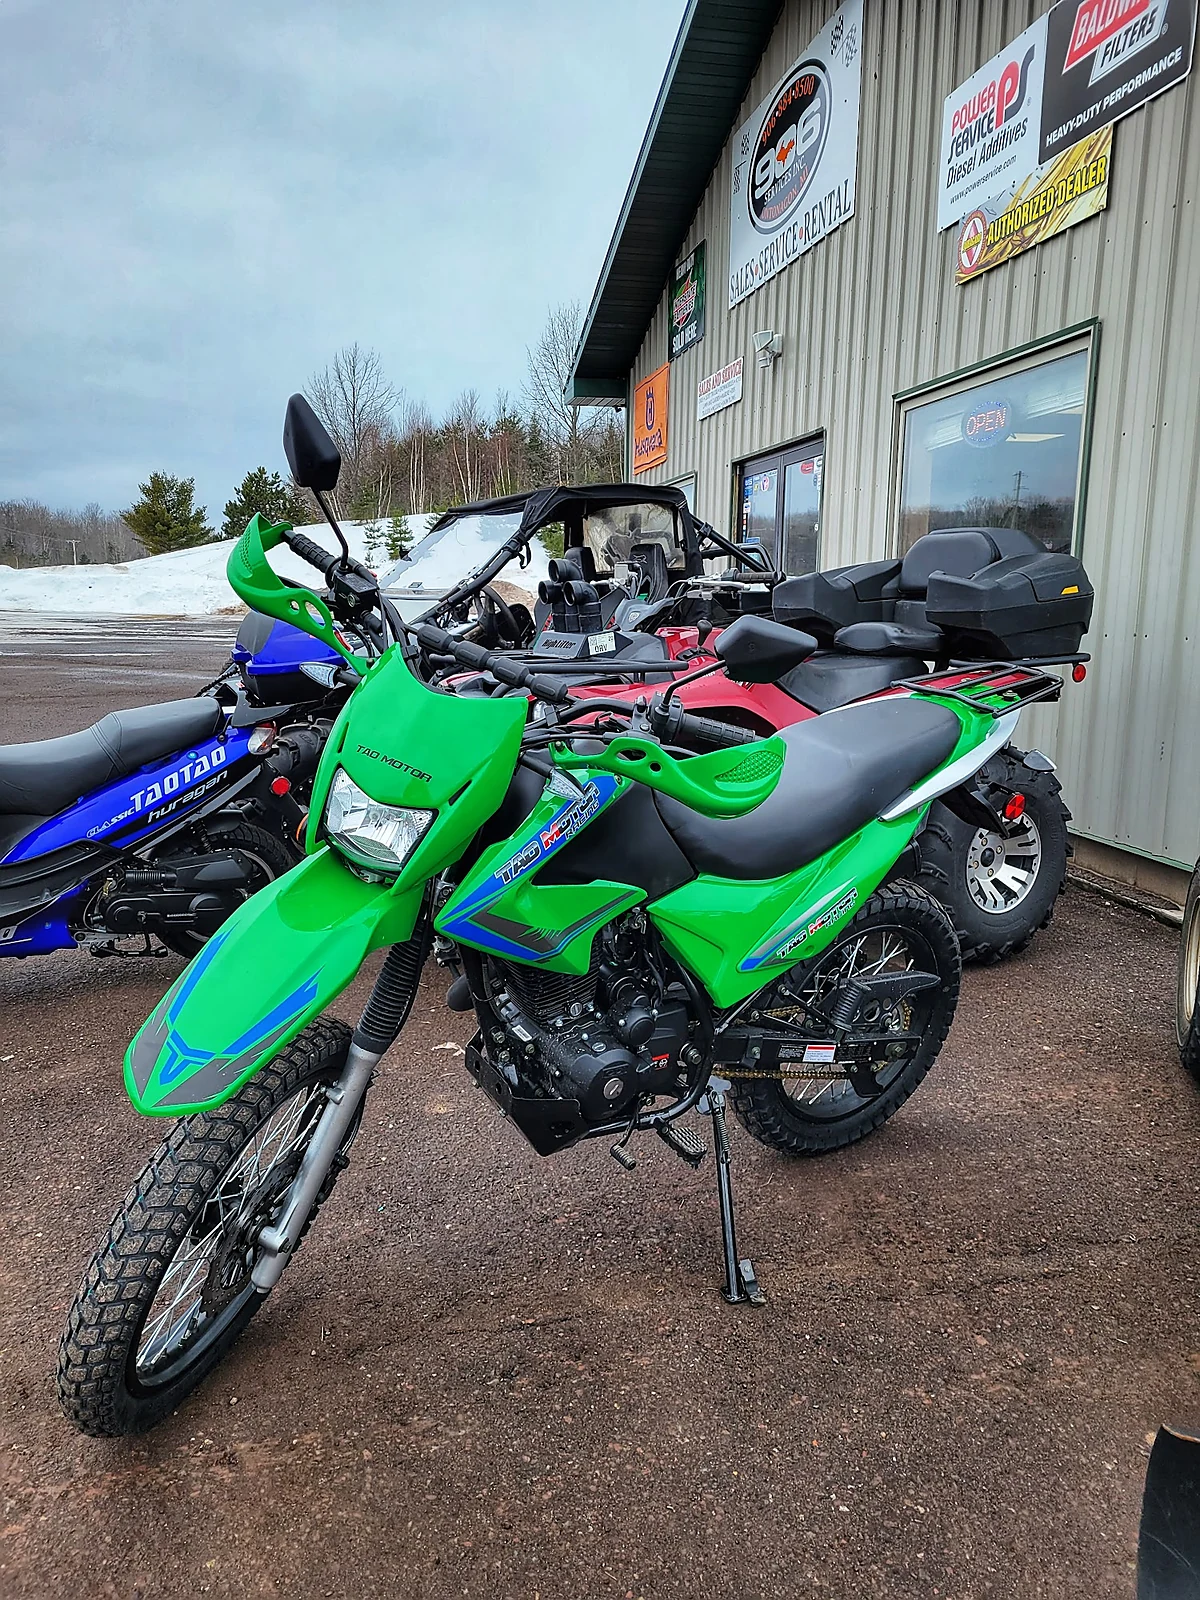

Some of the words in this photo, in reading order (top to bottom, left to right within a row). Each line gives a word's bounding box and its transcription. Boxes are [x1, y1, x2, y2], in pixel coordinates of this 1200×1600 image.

[1074, 0, 1142, 52] BALD
[1101, 6, 1158, 68] FILTERS
[951, 80, 997, 136] POWER
[1045, 99, 1103, 148] HEAVY-DUTY
[1102, 46, 1183, 112] PERFORMANCE
[755, 97, 821, 199] 906
[946, 149, 977, 189] Diesel
[978, 117, 1028, 168] Additives
[947, 106, 996, 165] SERVICE
[764, 169, 792, 205] SERVICES
[950, 154, 1018, 205] www.powerservice.com
[986, 186, 1055, 247] AUTHORIZED
[1057, 155, 1107, 206] DEALER
[731, 258, 755, 302] SALES
[758, 221, 799, 281] SERVICE
[804, 178, 852, 246] RENTAL
[966, 407, 1007, 435] OPEN
[130, 745, 227, 813] TAOTAO
[356, 744, 381, 760] TAO
[380, 755, 433, 783] MOTOR
[86, 806, 136, 839] CLASSIC
[147, 770, 228, 824] huragan
[493, 840, 542, 885] TAO
[540, 781, 601, 851] MOTOR
[776, 929, 808, 959] TAO
[808, 886, 859, 936] MOTOR
